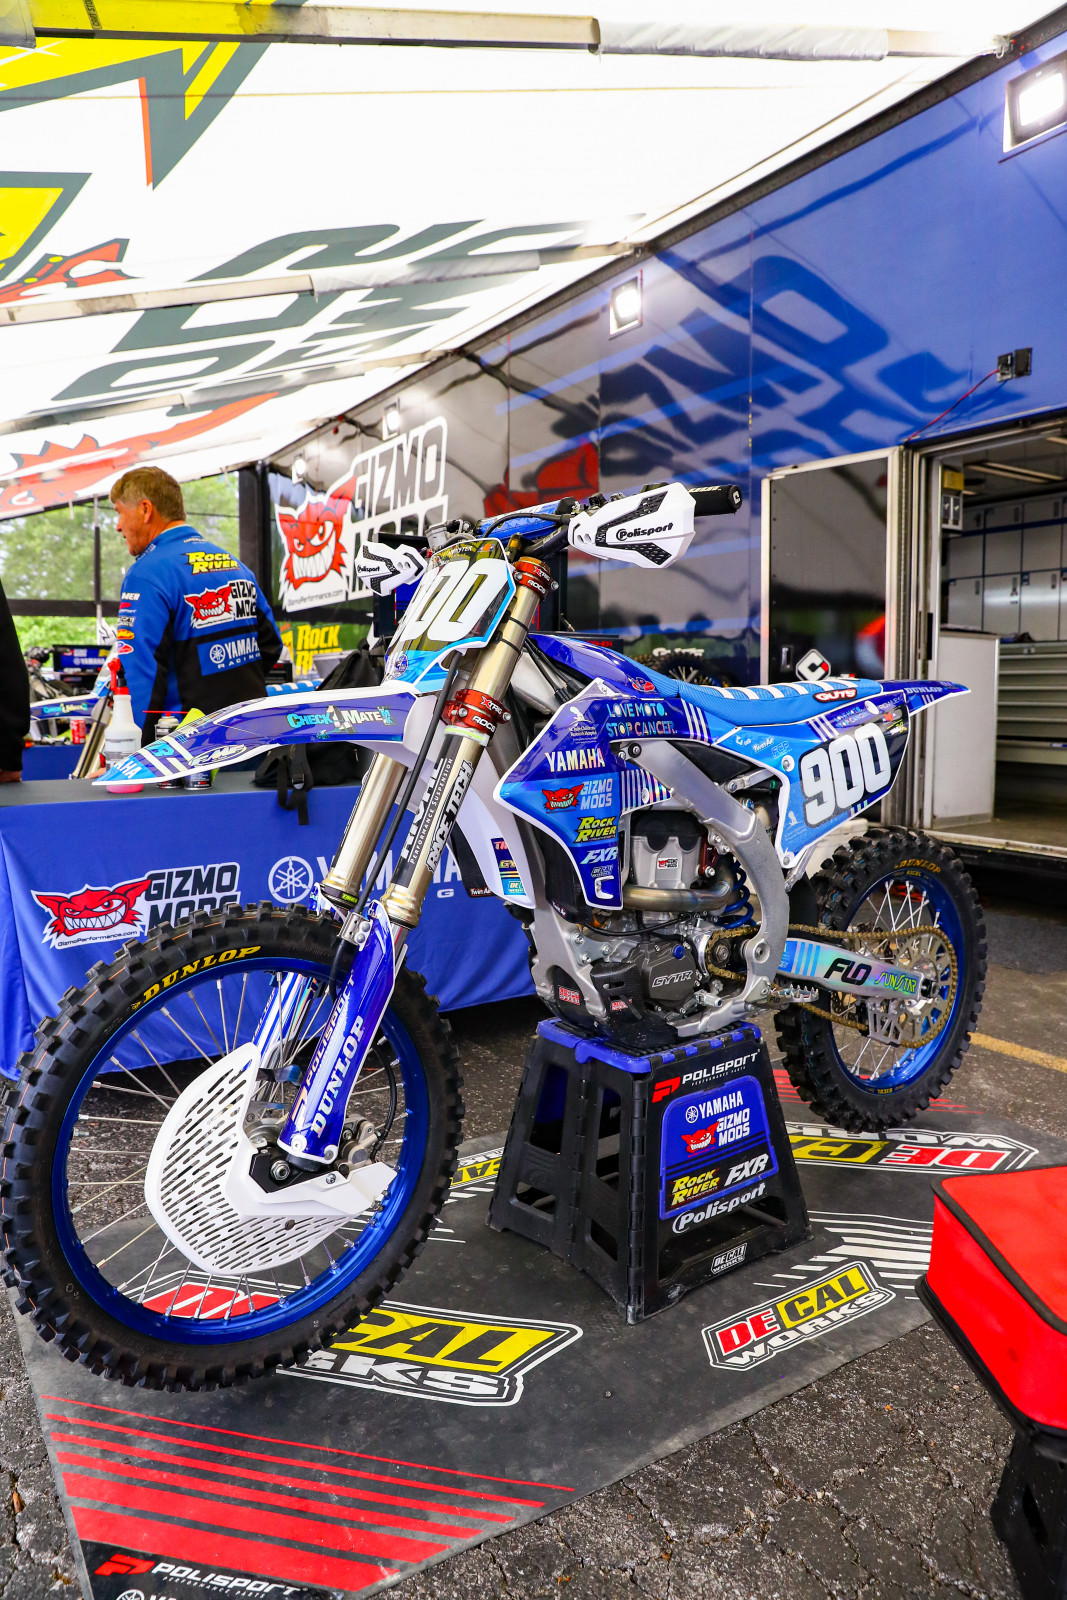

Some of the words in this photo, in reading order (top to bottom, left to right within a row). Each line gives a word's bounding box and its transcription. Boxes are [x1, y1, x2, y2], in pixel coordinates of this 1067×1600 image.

[353, 423, 445, 519] GIZMO
[617, 522, 674, 541] Polisport
[187, 552, 230, 563] ROCK
[190, 560, 238, 574] RIVER
[236, 600, 257, 618] MOD
[225, 637, 260, 660] YAMAH
[297, 624, 340, 650] ROCK
[815, 689, 857, 701] GUTS
[904, 686, 943, 694] DUNLOP
[286, 712, 335, 729] CHECK
[340, 709, 382, 724] MATE
[606, 704, 635, 718] LOVE
[606, 722, 633, 738] STOP
[634, 720, 678, 736] CANCER.
[545, 748, 605, 772] YAMAHA
[801, 723, 890, 824] 900
[581, 779, 613, 795] GIZMO
[410, 806, 437, 864] PERFORMANCE
[432, 758, 453, 806] SUSPENSION
[580, 793, 613, 810] MODS
[426, 814, 452, 872] RACE
[447, 760, 473, 821] TECH
[580, 817, 613, 830] ROCK
[576, 826, 616, 842] RIVER
[580, 846, 618, 864] FXR
[894, 859, 940, 872] DUNLOP
[145, 865, 237, 902] GIZMO
[57, 930, 138, 947] GizmoPerformance.com
[143, 946, 262, 1003] DUNLOP
[652, 969, 693, 988] GYTR
[824, 957, 872, 986] FLO
[875, 970, 917, 994] SUNSTAR
[305, 975, 355, 1091] POLISPORT
[310, 1015, 364, 1138] DUNLOP
[681, 1051, 758, 1084] POLISPORT
[691, 1071, 729, 1086] PERFORMANCE
[730, 1066, 746, 1076] PARTS
[698, 1090, 743, 1119] YAMAHA
[716, 1108, 749, 1132] GIZMO
[718, 1122, 750, 1147] MODS
[673, 1170, 716, 1193] ROCK
[723, 1154, 769, 1187] FXR
[670, 1177, 720, 1206] RIVER
[673, 1183, 766, 1234] Polisport
[713, 1256, 745, 1273] WORKS
[714, 1248, 745, 1267] DECAL
[716, 1267, 870, 1355] DECAL
[724, 1290, 887, 1364] WORKS
[151, 1562, 301, 1596] POLISPORT
[162, 1576, 231, 1594] PERFORMANCE
[235, 1591, 267, 1599] PARTS
